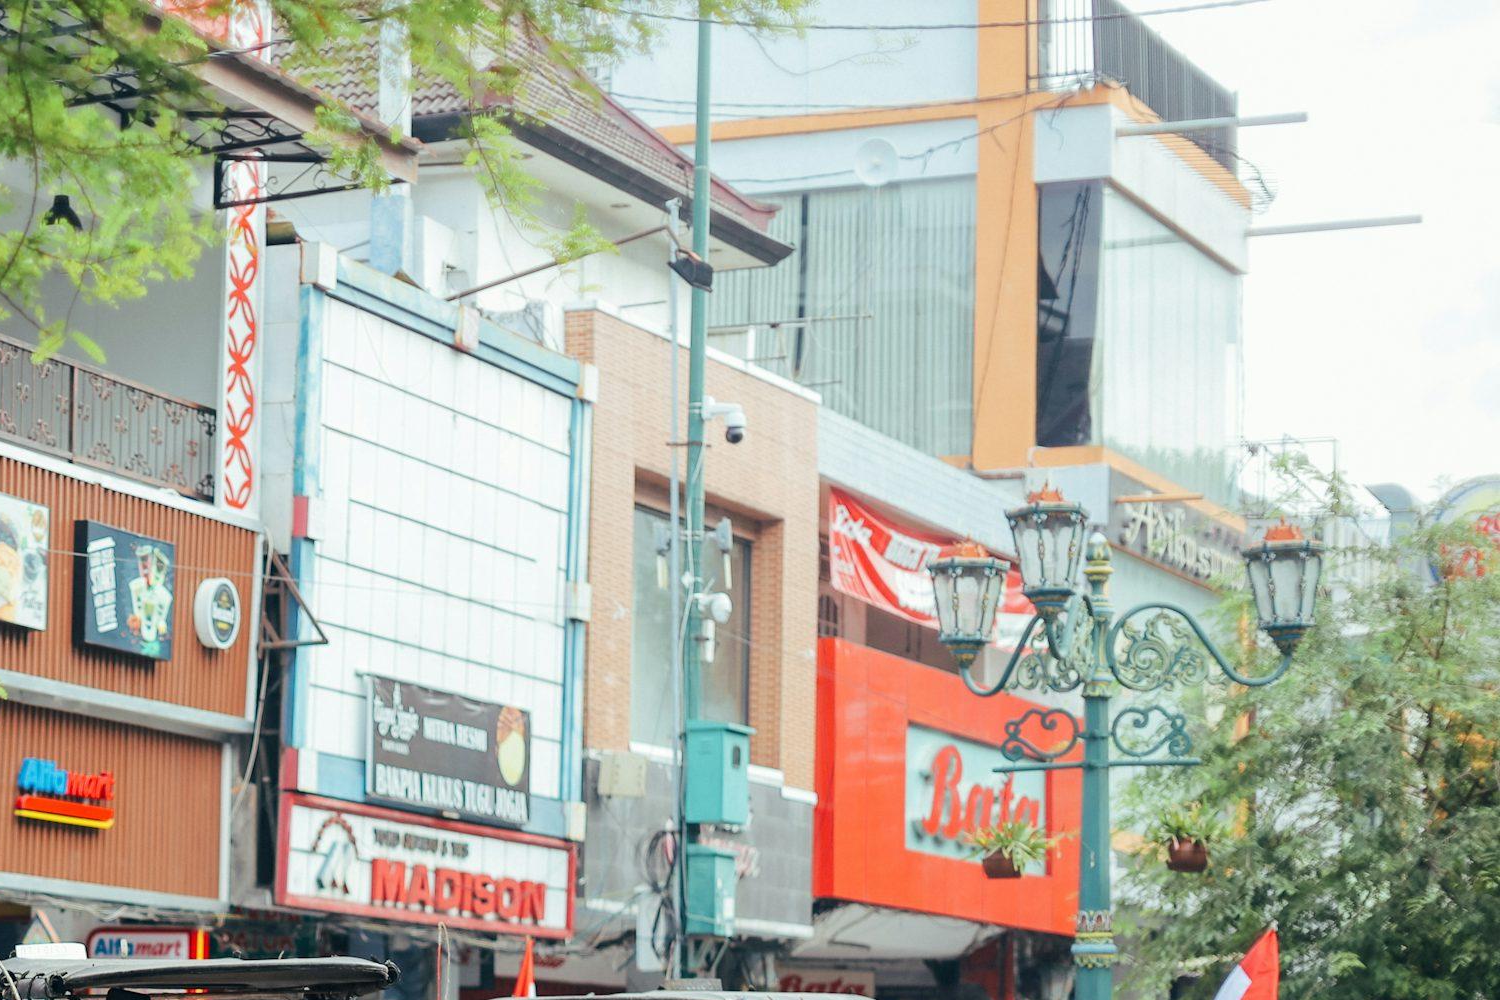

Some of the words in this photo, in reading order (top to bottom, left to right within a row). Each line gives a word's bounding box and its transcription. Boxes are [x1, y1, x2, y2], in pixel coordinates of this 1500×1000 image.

[18, 757, 114, 801] Alfamart
[375, 763, 421, 801] BAKPIA
[922, 744, 1040, 840] Bata
[372, 858, 547, 921] MADISON
[94, 938, 182, 958] Alfamart
